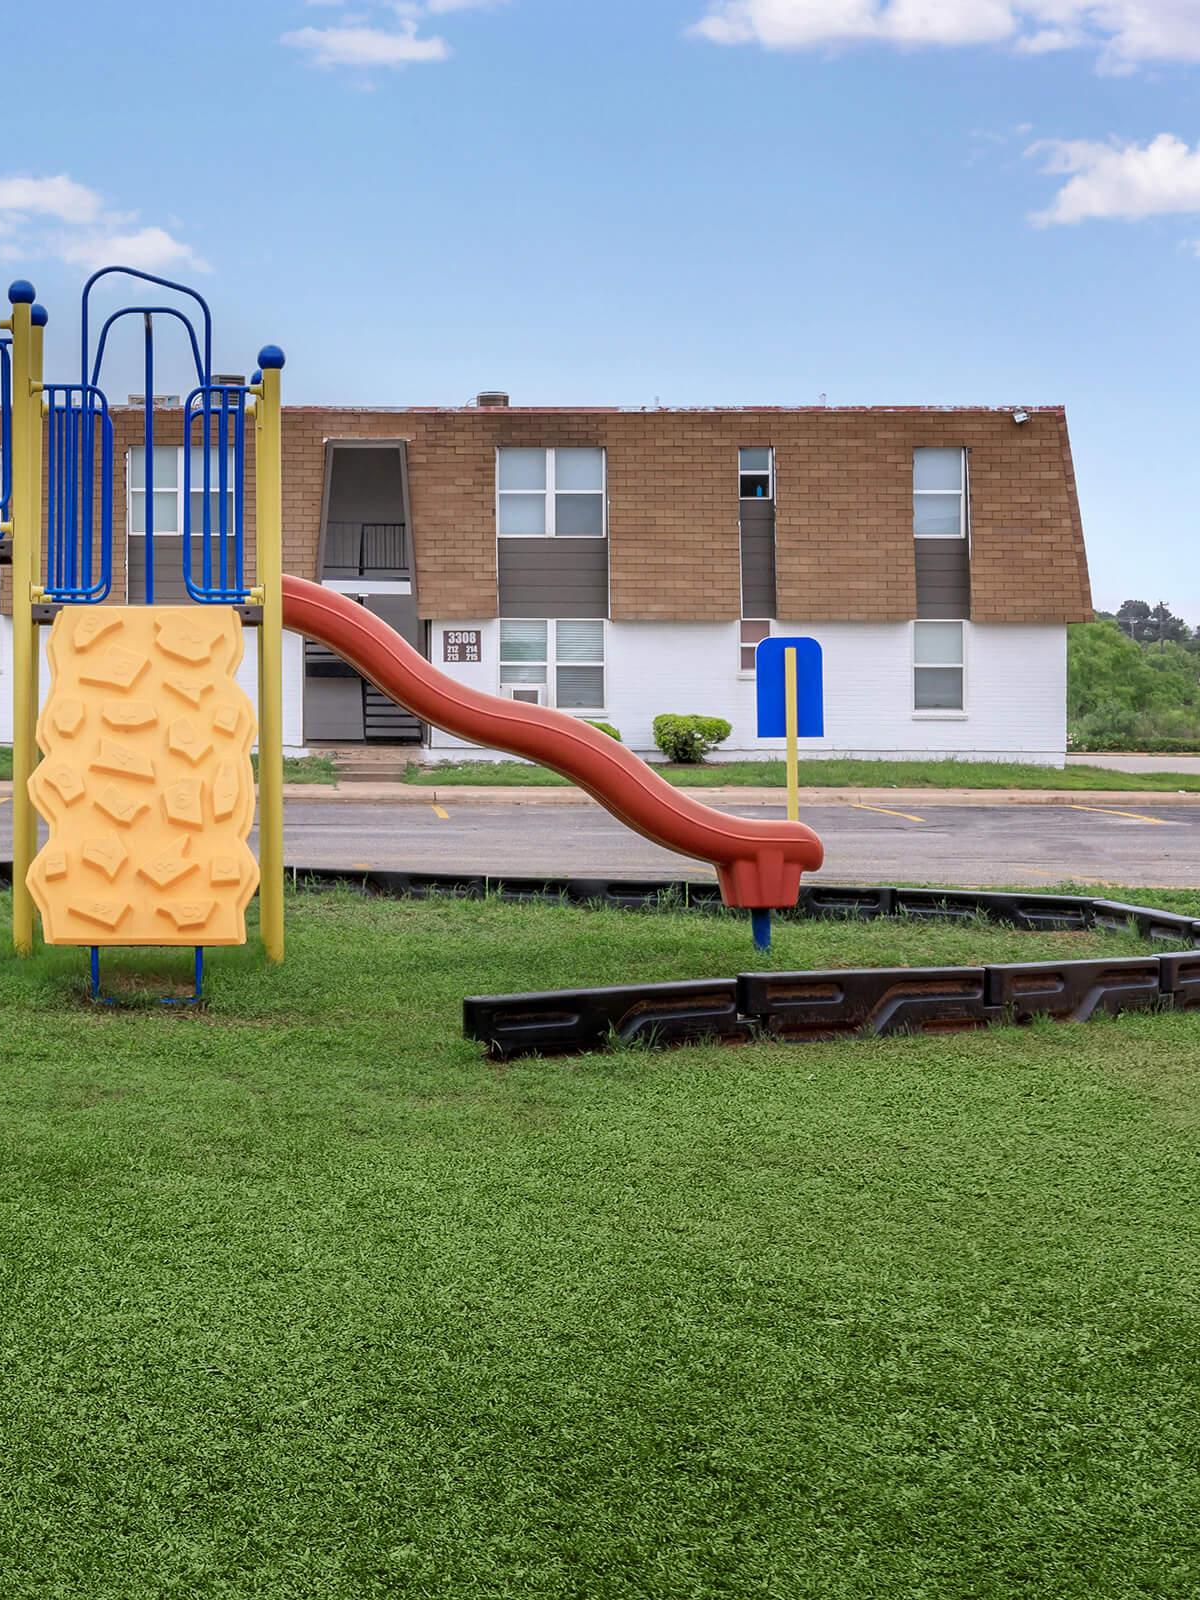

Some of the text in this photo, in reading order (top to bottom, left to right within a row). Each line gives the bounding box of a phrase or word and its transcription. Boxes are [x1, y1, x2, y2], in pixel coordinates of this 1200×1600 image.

[448, 632, 476, 644] 3308
[447, 645, 477, 653] 212 214
[447, 653, 478, 661] 213 215
